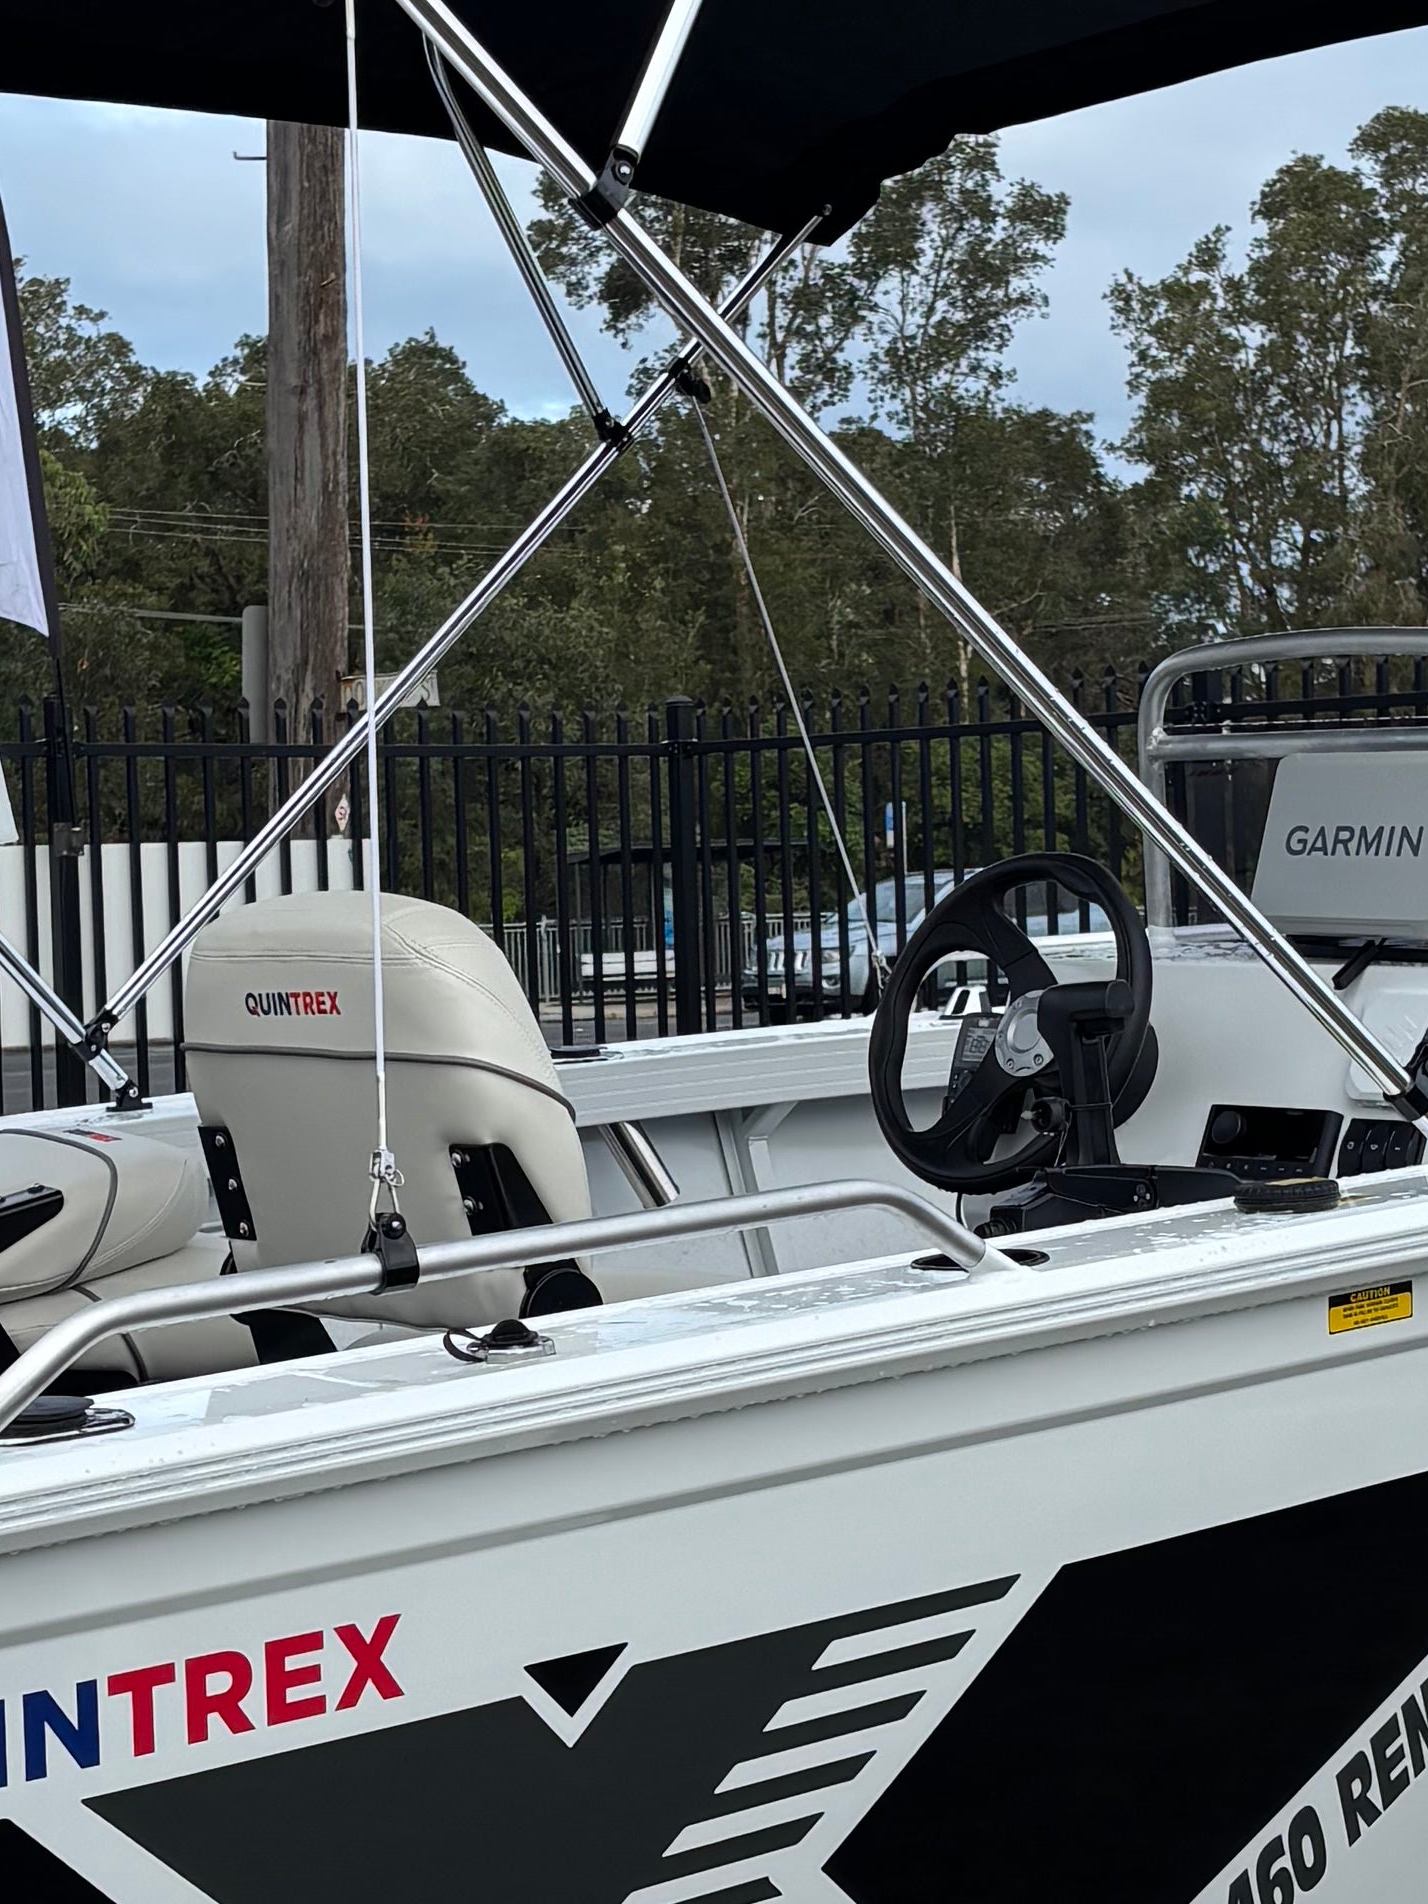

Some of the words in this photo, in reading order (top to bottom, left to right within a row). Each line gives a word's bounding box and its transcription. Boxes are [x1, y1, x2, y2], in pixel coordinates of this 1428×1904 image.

[1285, 825, 1424, 857] GARMIN
[245, 991, 341, 1017] QUINTREX
[1349, 1286, 1391, 1302] CAUTION
